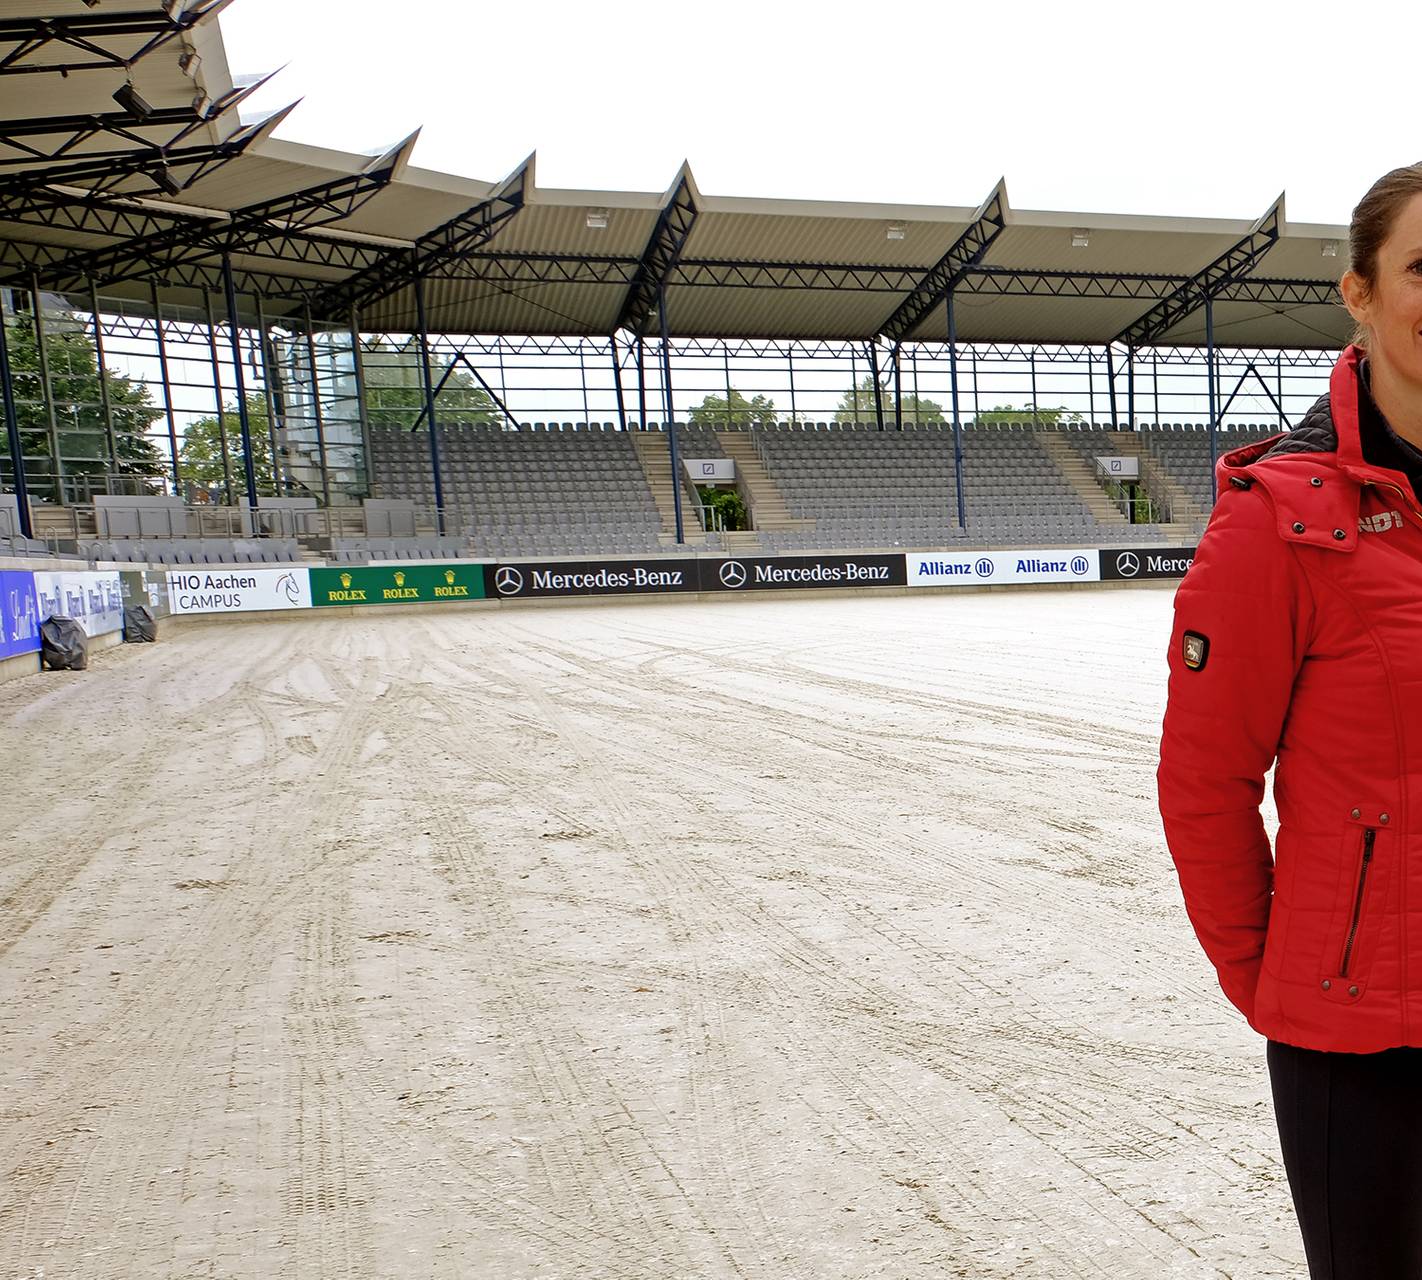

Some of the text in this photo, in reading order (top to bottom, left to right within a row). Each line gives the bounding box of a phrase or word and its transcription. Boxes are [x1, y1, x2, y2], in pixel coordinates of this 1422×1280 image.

[1359, 511, 1403, 532] NDT
[754, 563, 889, 583] Mercedes-Benz
[918, 561, 972, 576] Allianz
[1016, 559, 1067, 573] Allianz
[204, 574, 257, 590] Aachen
[531, 567, 682, 590] Mercedes-Benz
[328, 590, 367, 601] ROLEX
[383, 588, 419, 599] ROLEX
[434, 586, 469, 596] ROLEX
[180, 593, 242, 610] CAMPUS
